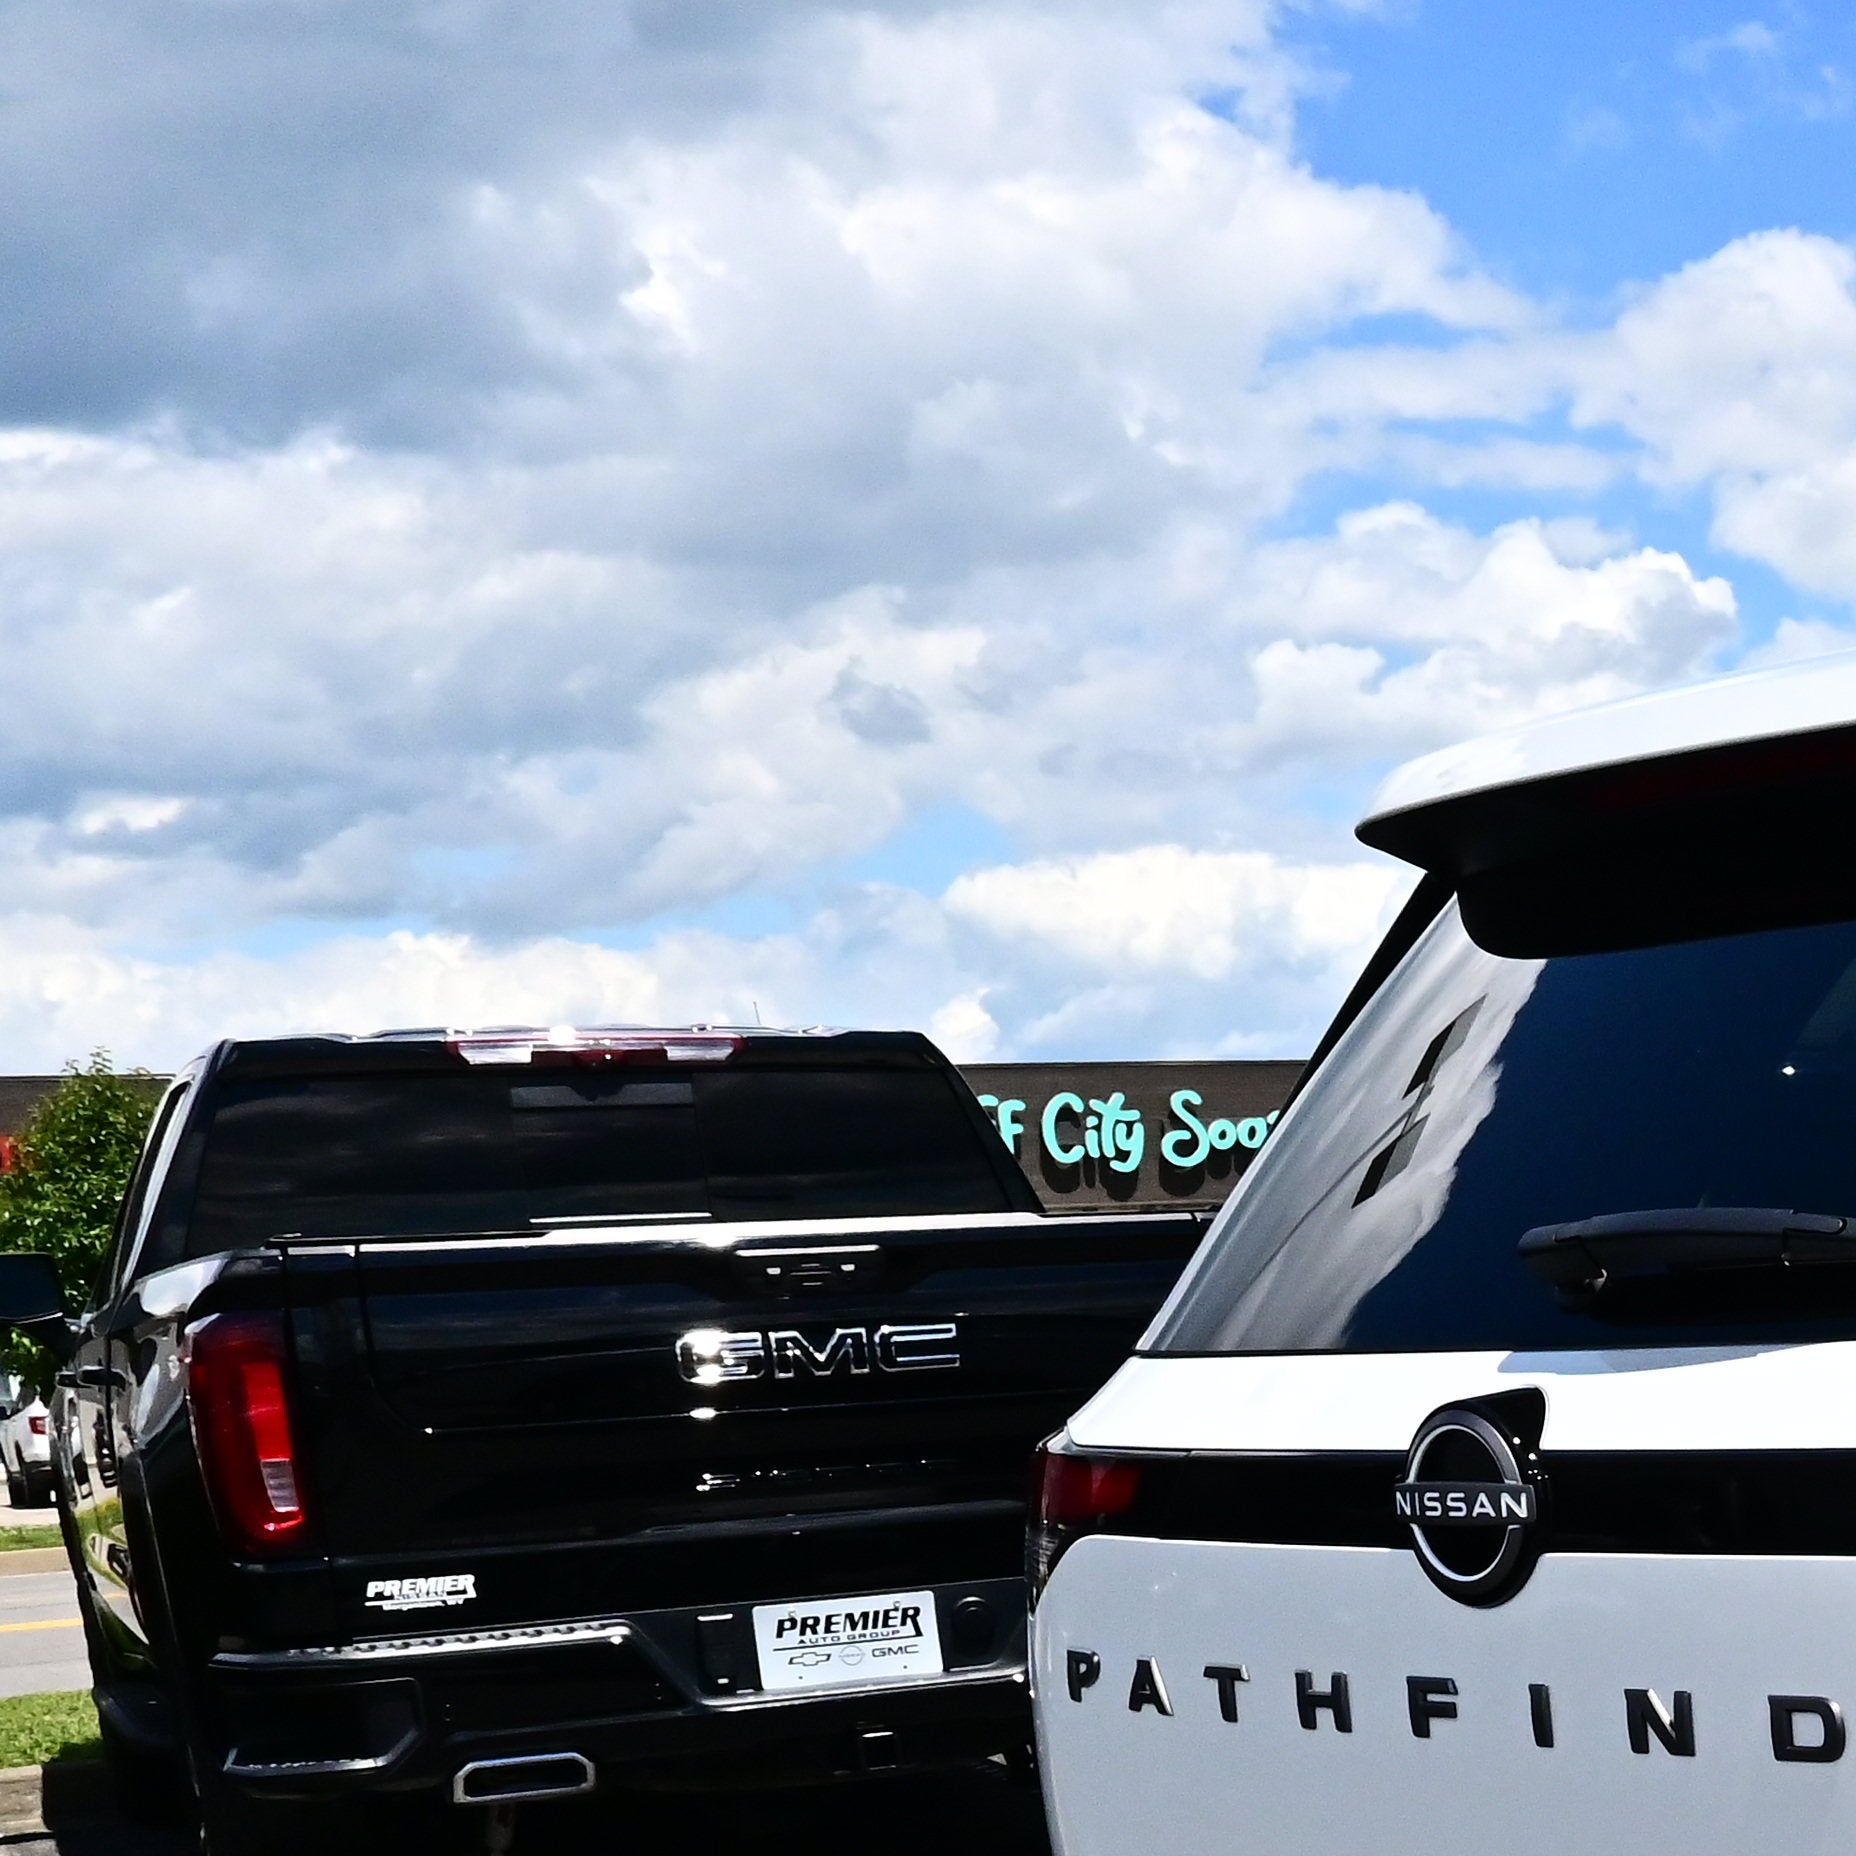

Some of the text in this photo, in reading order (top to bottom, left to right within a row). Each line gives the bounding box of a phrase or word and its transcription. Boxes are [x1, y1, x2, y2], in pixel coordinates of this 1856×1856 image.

[1042, 1091, 1145, 1172] City
[675, 1323, 960, 1384] GMC
[1395, 1491, 1528, 1518] NISSAN
[366, 1574, 476, 1598] PREMIER
[775, 1606, 923, 1639] PREMIER
[798, 1630, 901, 1645] AUTO GROUP
[871, 1644, 920, 1658] GMC
